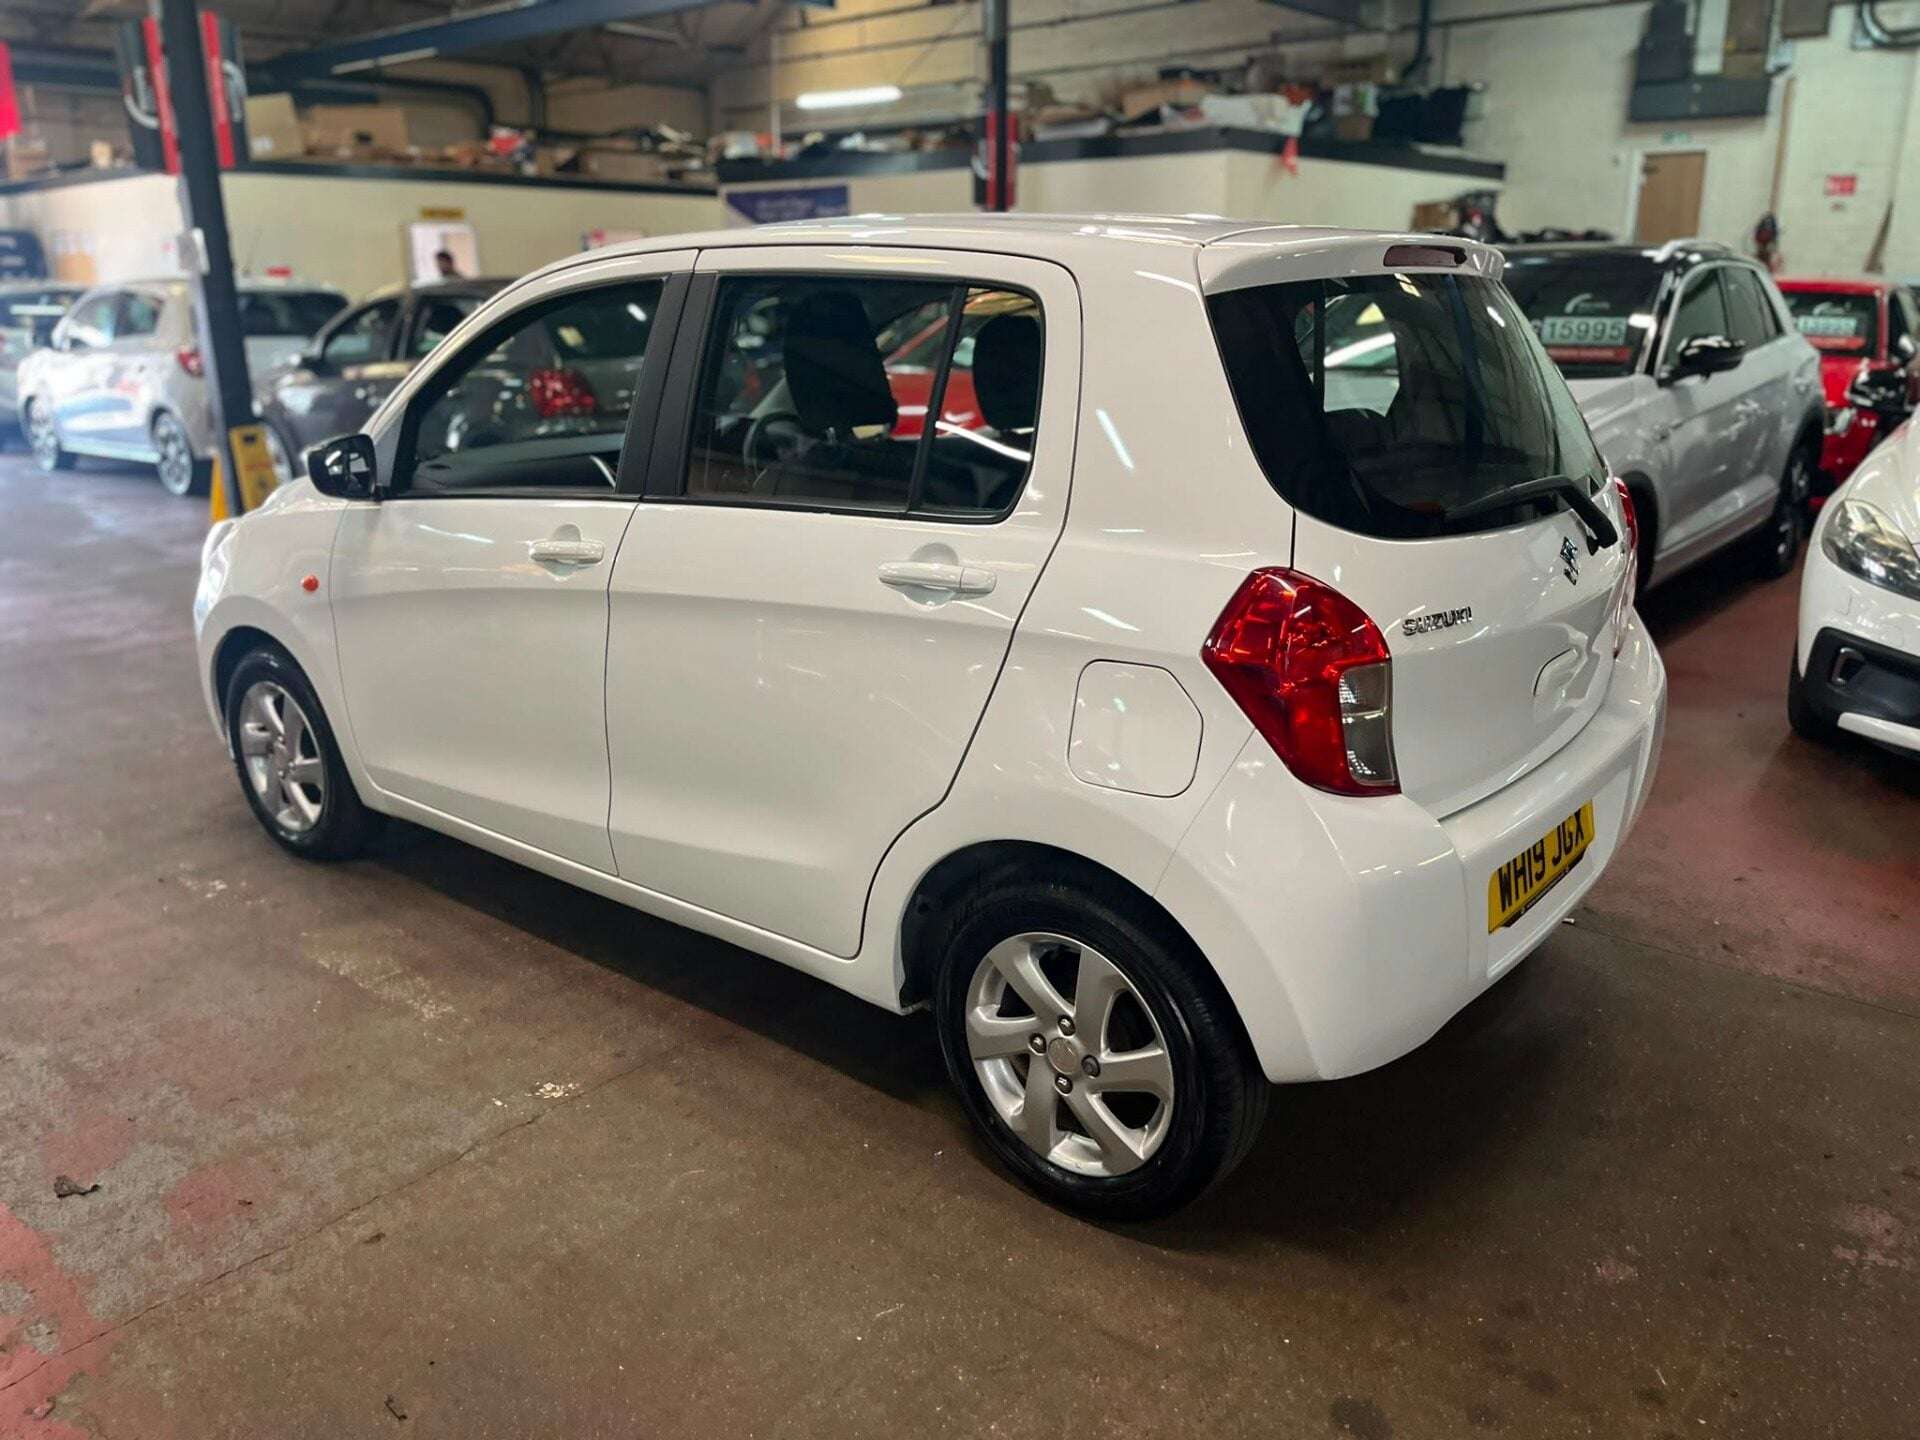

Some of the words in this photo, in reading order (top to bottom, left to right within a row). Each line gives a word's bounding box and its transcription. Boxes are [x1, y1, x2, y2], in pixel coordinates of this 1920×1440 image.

[1402, 606, 1472, 636] SUZUKI
[1498, 838, 1545, 913] WH19
[1552, 807, 1584, 866] JGX
